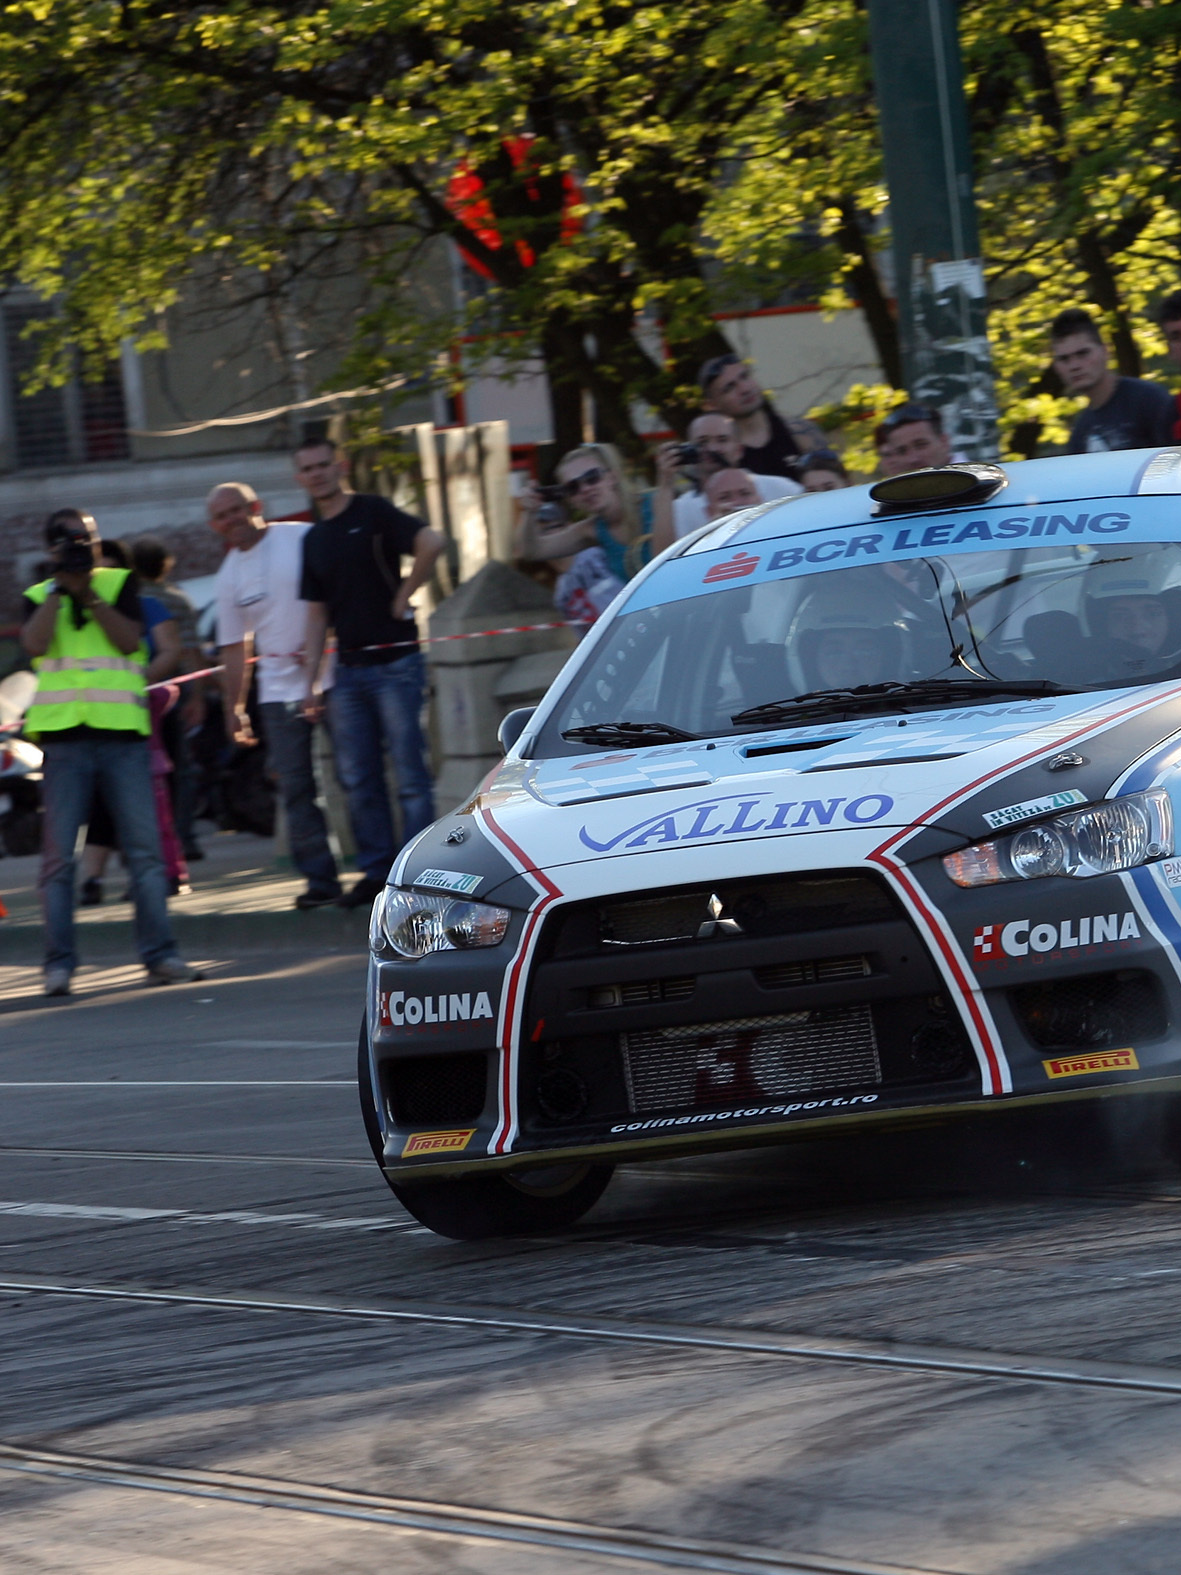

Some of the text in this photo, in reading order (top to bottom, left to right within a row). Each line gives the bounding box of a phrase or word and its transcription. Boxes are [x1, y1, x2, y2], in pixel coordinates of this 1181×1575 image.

[766, 512, 1132, 572] BCR LEASING
[1047, 792, 1075, 808] ZU
[579, 791, 895, 852] VALLINO
[451, 874, 476, 890] ZU
[1001, 911, 1141, 957] COLINA
[389, 991, 494, 1026] COLINA
[1050, 1050, 1131, 1075] PIRELLI
[610, 1093, 879, 1134] colinamotorsport.ro
[406, 1131, 471, 1152] PIRELLI
